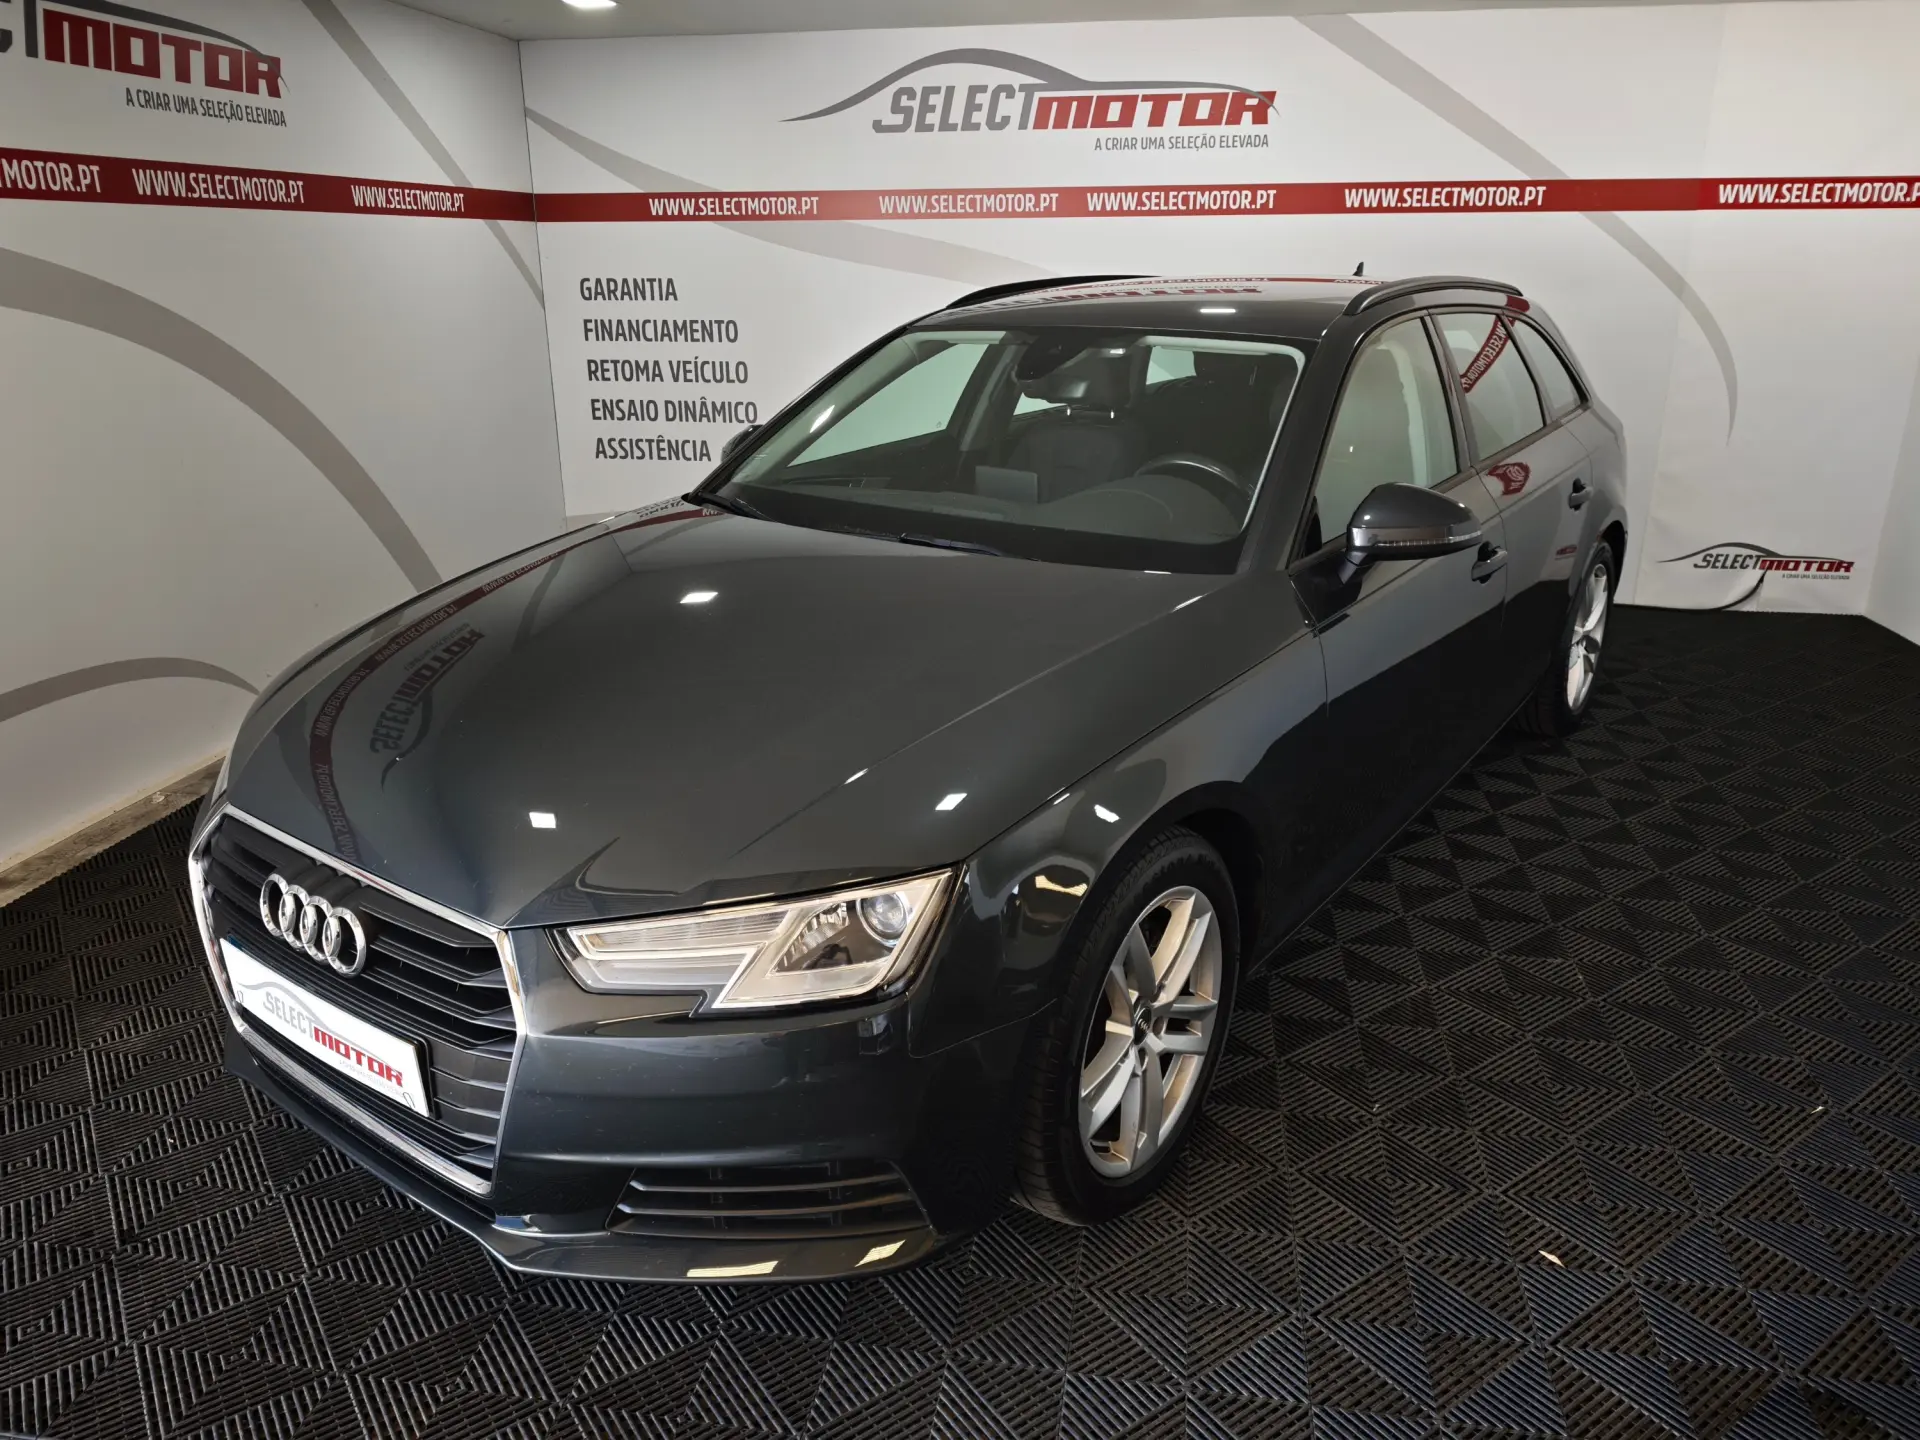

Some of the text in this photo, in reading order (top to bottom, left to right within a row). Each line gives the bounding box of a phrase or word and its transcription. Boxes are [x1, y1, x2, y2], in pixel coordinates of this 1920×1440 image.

[125, 87, 287, 127] A CRIAR UMA SELEÇÃO ELEVADA
[1094, 133, 1269, 152] A CRIAR UMA SELEÇÃO ELEVADA
[0, 158, 101, 193] MOTOR.PT
[132, 168, 305, 204] WWW.SELECTMOTOR.PT
[351, 185, 465, 213] WWW.SELECTMOTOR.PT
[649, 196, 819, 216] WWW.SELECTMOTOR.PT
[879, 192, 1059, 214] WWW.SELECTMOTOR.PT
[1087, 189, 1277, 212] WWW.SELECTMOTOR.PT
[1344, 186, 1547, 209] WWW.SELECTMOTOR.PT
[580, 277, 678, 302] GARANTIA
[583, 319, 739, 343] FINANCIAMENTO
[587, 356, 749, 384] RETOMA VEÍCULO
[590, 397, 758, 424] ENSAIO DINÂMICO
[595, 435, 712, 462] ASSISTÊNCIA
